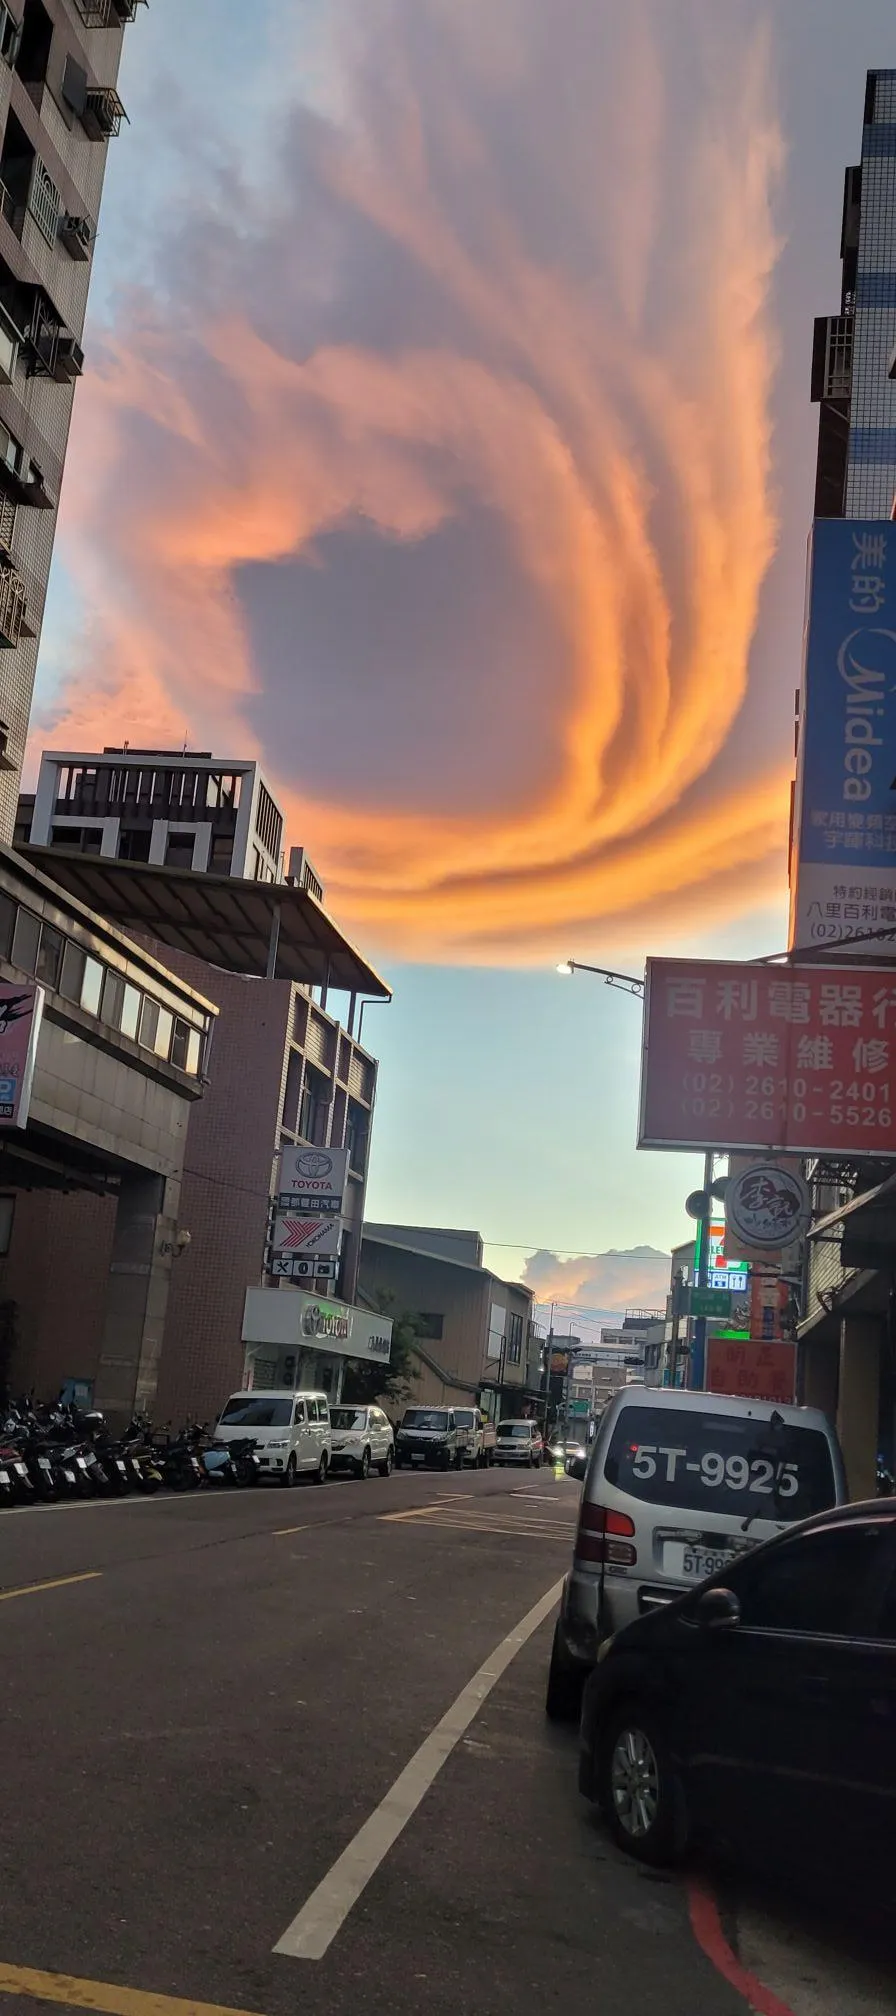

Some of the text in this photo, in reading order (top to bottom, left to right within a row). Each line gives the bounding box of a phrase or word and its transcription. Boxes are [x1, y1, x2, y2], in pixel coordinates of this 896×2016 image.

[851, 532, 888, 614] 美的
[839, 638, 890, 802] Midea
[833, 884, 896, 902] 特約經銷
[665, 976, 896, 1029] 百利電器行
[688, 1030, 890, 1074] 專業維修
[682, 1073, 890, 1103] (02) 2610-2401
[682, 1098, 892, 1127] (02) 2610-5526
[291, 1179, 333, 1190] TOYOTA
[305, 1223, 335, 1248] YOKOHAMA
[632, 1445, 799, 1497] 5T-9925
[683, 1553, 732, 1575] 5T-99
